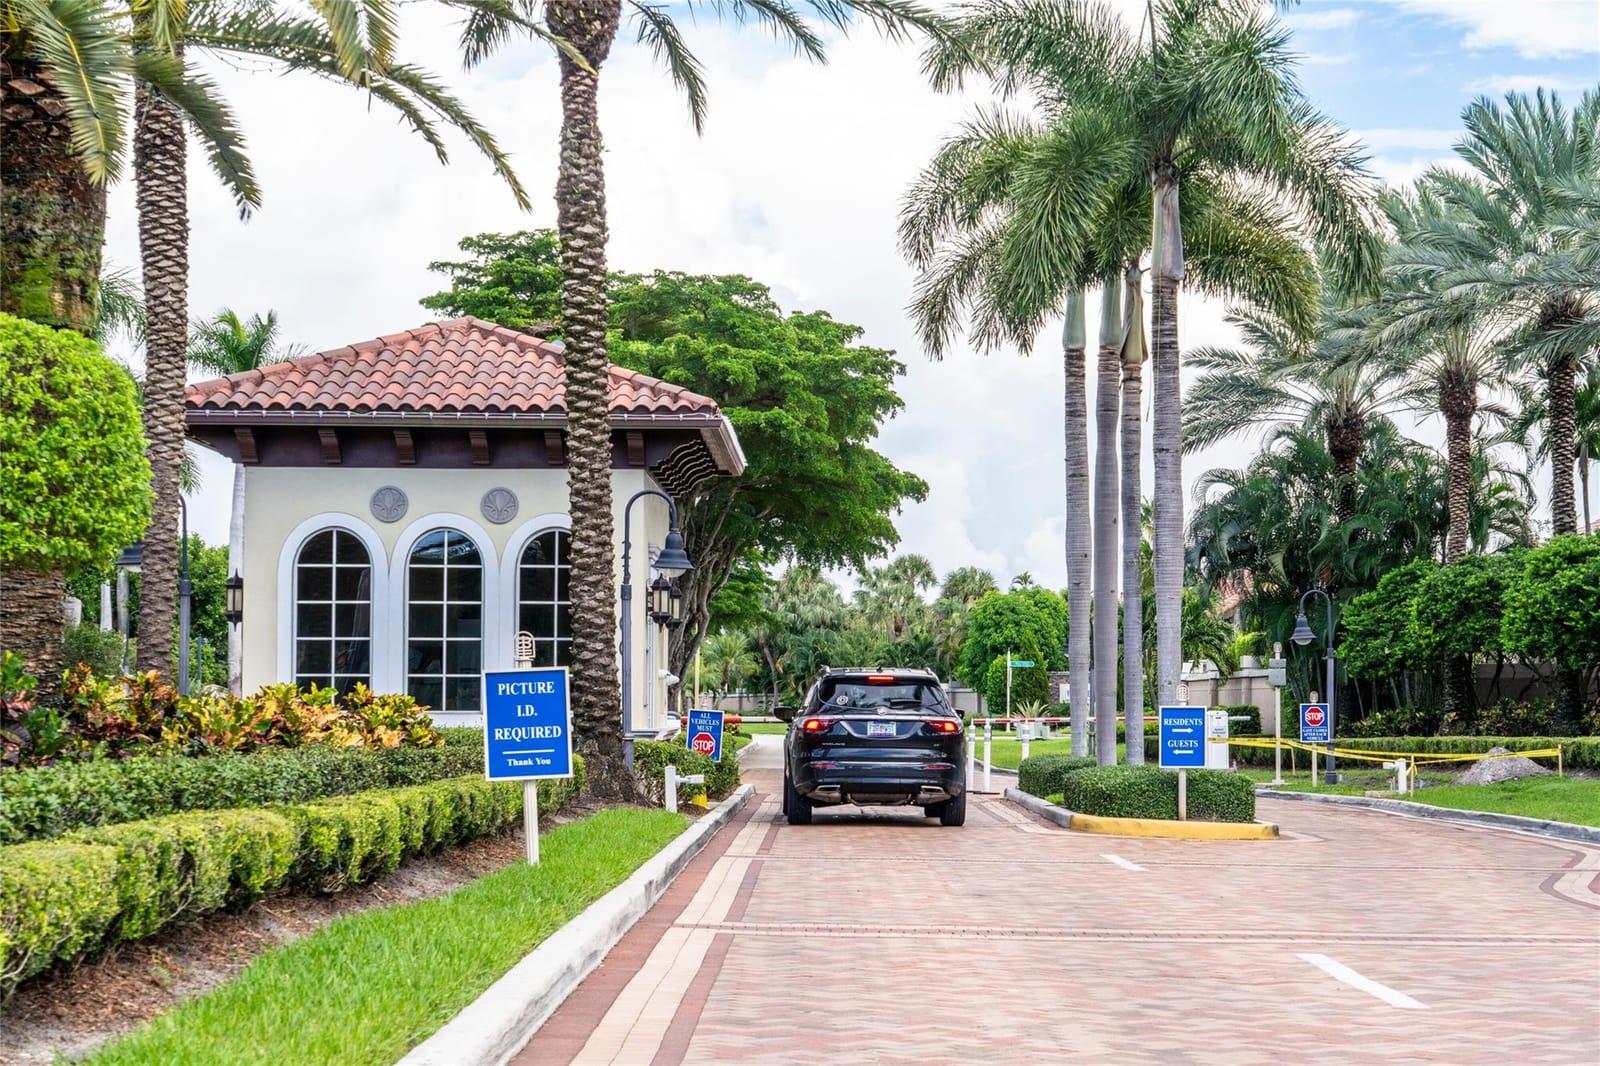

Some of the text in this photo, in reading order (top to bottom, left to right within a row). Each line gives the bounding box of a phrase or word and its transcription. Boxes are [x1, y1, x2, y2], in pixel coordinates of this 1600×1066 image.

[498, 681, 555, 696] PICTURE
[517, 705, 538, 717] I.D.
[1306, 712, 1323, 721] STOP
[691, 718, 720, 726] VEHICLES
[1163, 718, 1203, 726] RESIDENTS
[495, 726, 562, 742] REQUIRED
[693, 740, 714, 751] STOP
[1167, 740, 1199, 748] GUESTS
[507, 757, 552, 767] Thank You
